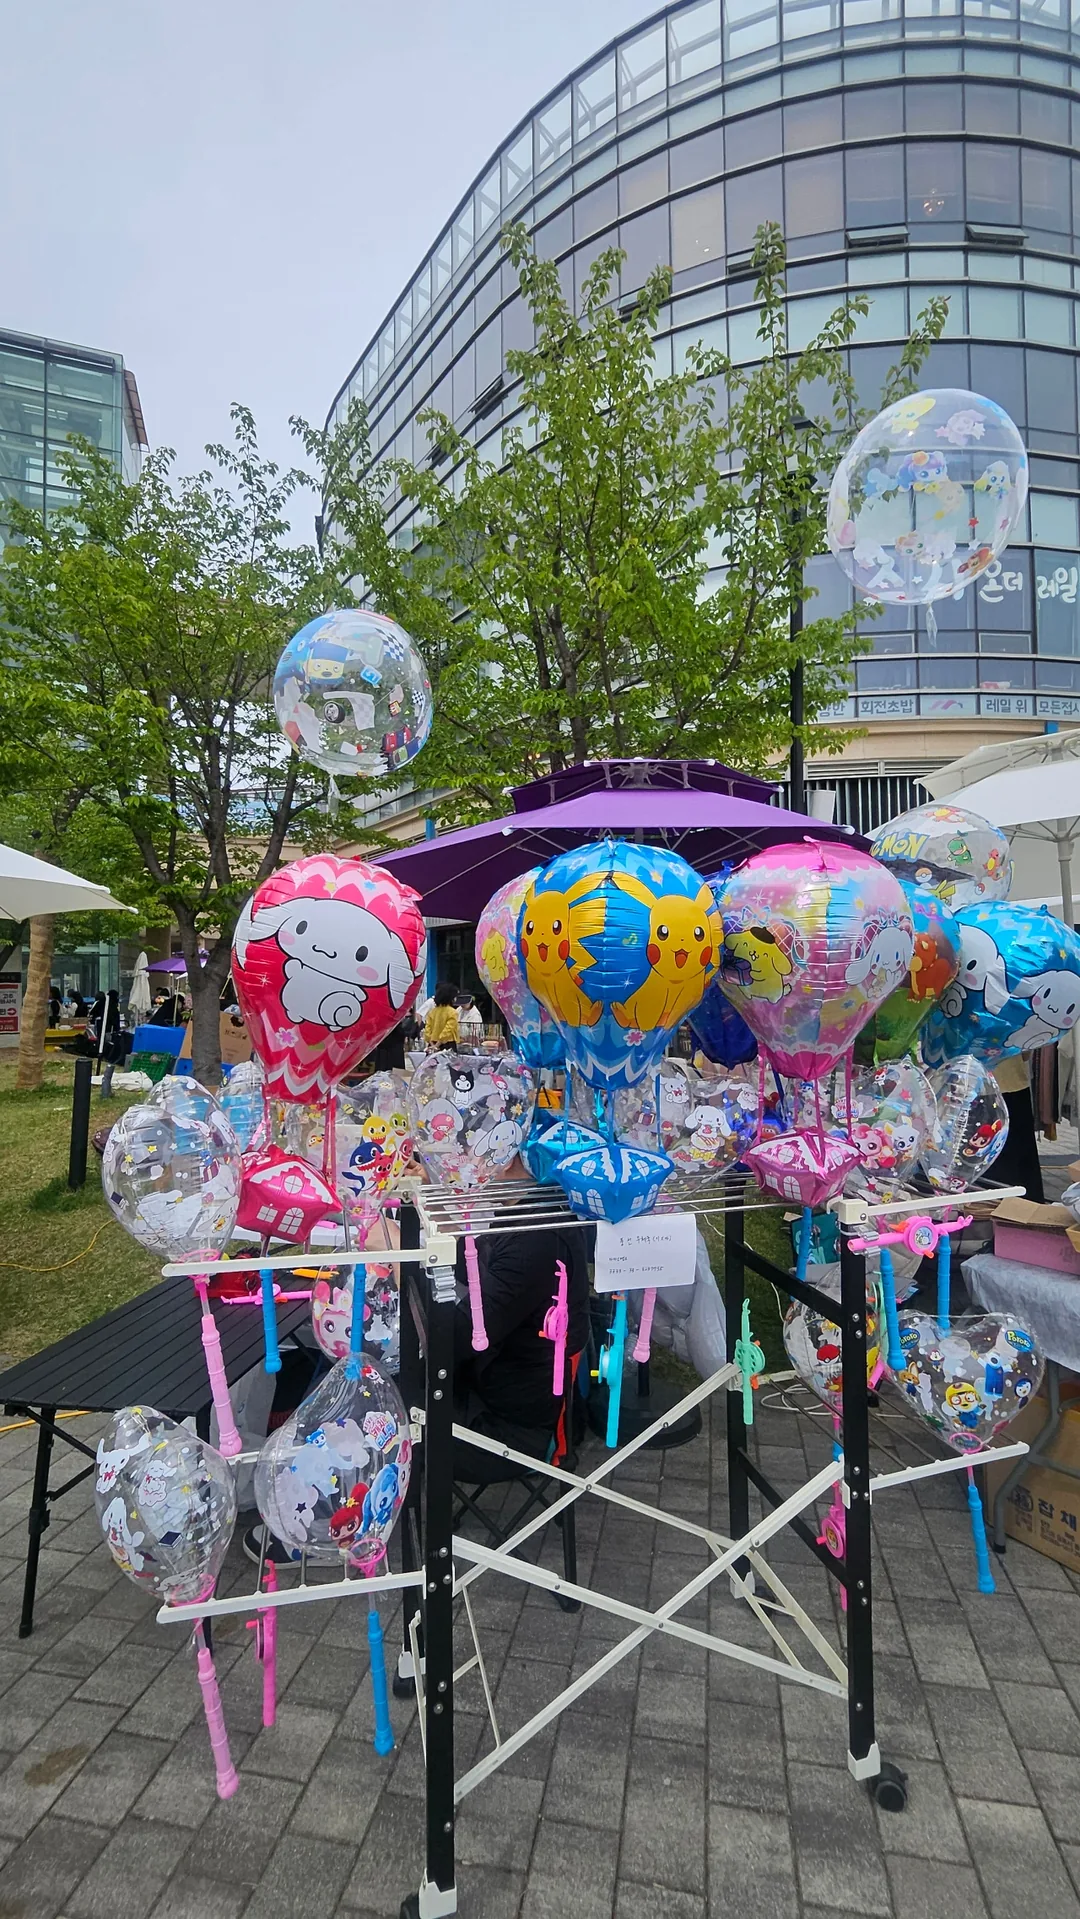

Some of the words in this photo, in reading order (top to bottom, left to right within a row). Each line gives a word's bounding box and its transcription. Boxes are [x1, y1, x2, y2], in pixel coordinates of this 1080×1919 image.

[979, 560, 1023, 603] 온더
[1037, 567, 1078, 603] 레일
[860, 699, 914, 714] 회전초밥
[986, 699, 1011, 713] 레일
[1015, 699, 1028, 713] 위
